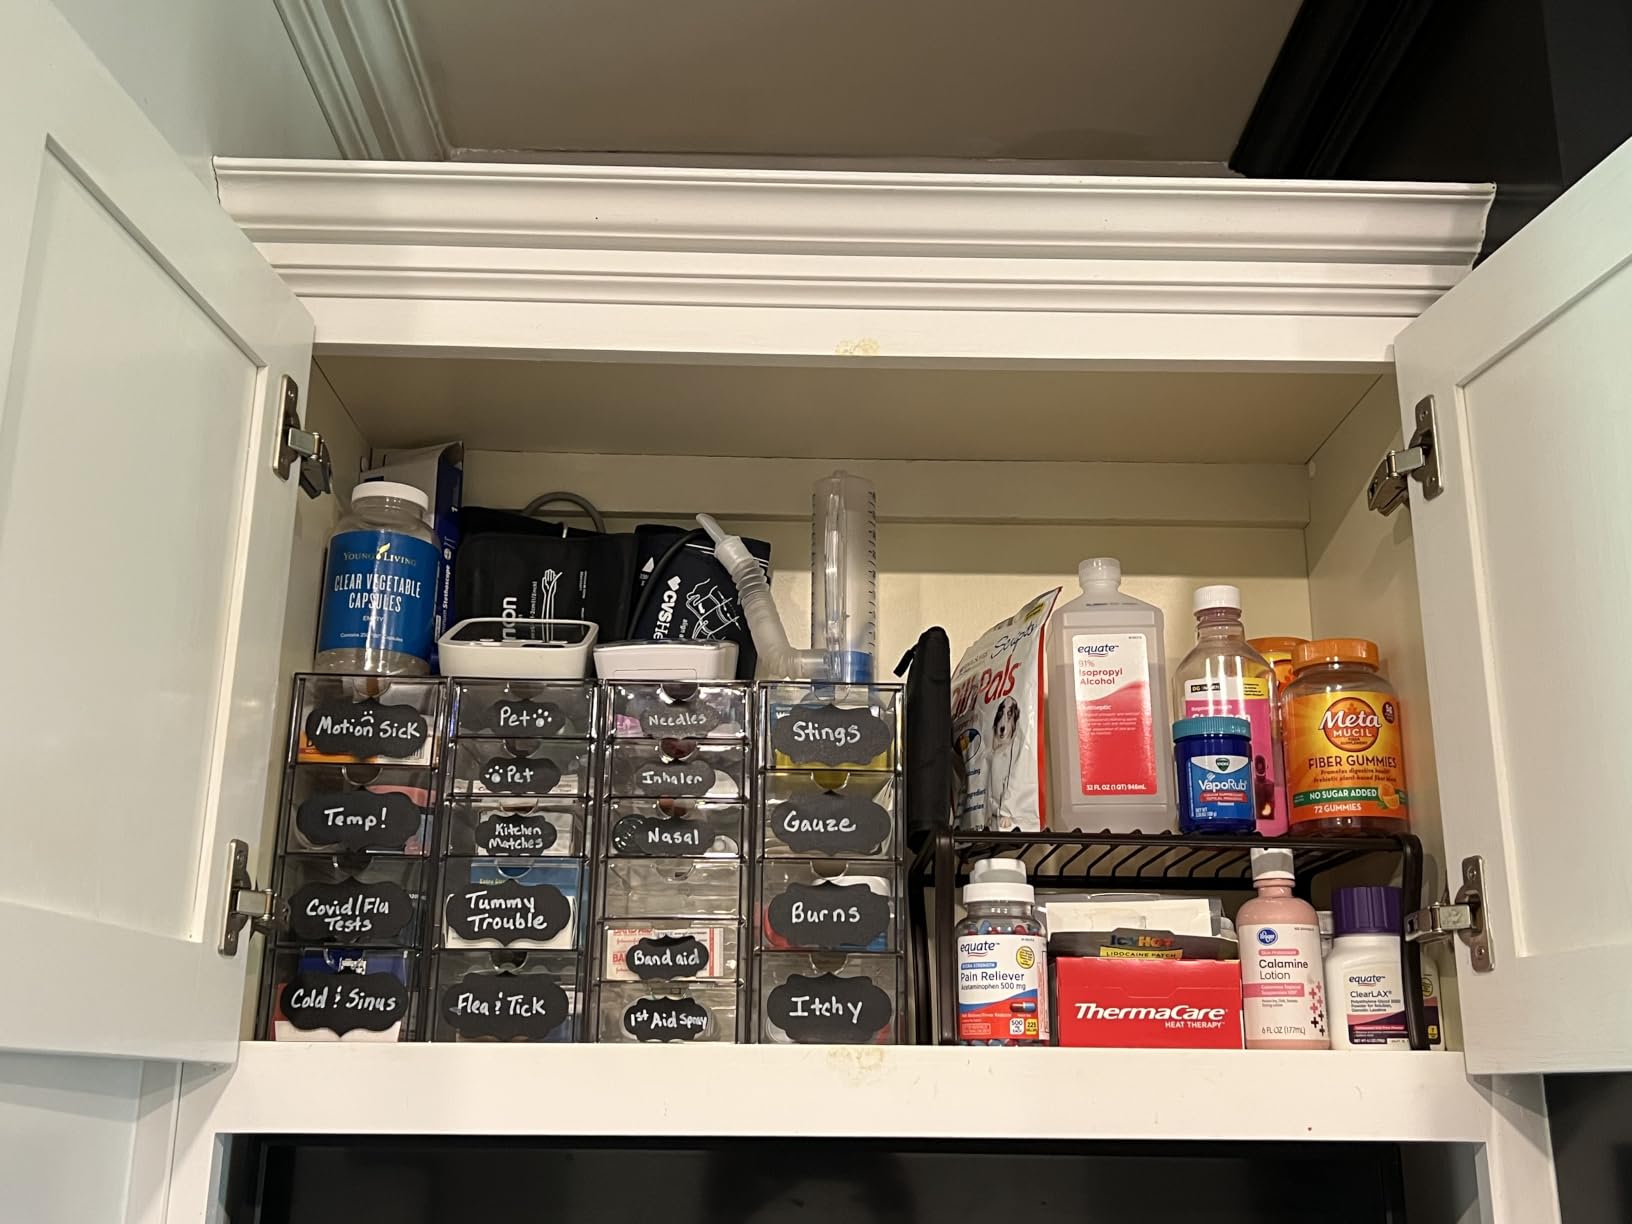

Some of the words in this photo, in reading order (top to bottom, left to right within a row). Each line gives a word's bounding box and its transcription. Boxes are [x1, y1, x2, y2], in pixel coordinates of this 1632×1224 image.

[383, 552, 417, 567] LIVING
[334, 573, 362, 592] CLEAR
[366, 573, 422, 598] VEGETABLE
[442, 564, 451, 609] Stethoscope
[348, 592, 402, 613] CAPSULES
[1077, 643, 1115, 656] equate
[1078, 659, 1095, 667] 91%
[978, 654, 1022, 705] Pals
[1079, 667, 1123, 677] Isopropyl
[1080, 677, 1115, 685] Alcohol
[500, 705, 530, 727] Pet
[648, 712, 707, 726] Needles
[1317, 710, 1383, 731] Meta
[315, 715, 374, 738] Motion
[792, 720, 861, 747] Stings
[1333, 728, 1373, 737] MUCIL
[1308, 755, 1343, 770] FIBER
[1346, 754, 1397, 769] GUMMIES
[507, 765, 535, 783] Pet
[1198, 778, 1247, 793] VapoRub
[1309, 792, 1321, 800] NO
[1322, 789, 1349, 799] SUGAR
[1350, 789, 1377, 798] ADDED
[1313, 805, 1323, 814] 72
[1324, 803, 1362, 813] GUMMIES
[323, 806, 388, 831] Temp!
[783, 810, 857, 833] Gauze
[494, 823, 542, 836] Kitchen
[647, 827, 699, 845] Nasal
[488, 836, 543, 849] Matches
[465, 890, 535, 912] Tummy
[791, 901, 861, 924] Burns
[324, 916, 373, 932] Tests
[466, 912, 548, 932] Trouble
[960, 941, 996, 955] equate
[633, 948, 673, 966] Band
[675, 948, 700, 965] aid
[1258, 959, 1309, 969] Calamine
[960, 971, 978, 982] Pain
[981, 970, 1025, 981] Reliever
[1259, 970, 1291, 980] Lotion
[1348, 974, 1382, 985] equate
[961, 983, 999, 991] Acetaminophen
[1000, 982, 1015, 990] 500
[1015, 983, 1026, 991] mg
[290, 986, 329, 1009] Cold
[345, 988, 397, 1011] Sinus
[456, 992, 490, 1016] Flea
[788, 995, 863, 1025] Itchy
[1074, 1002, 1225, 1021] ThermaCare
[630, 1009, 649, 1027] 1st
[650, 1011, 678, 1030] Aid
[679, 1013, 708, 1030] Spray
[1187, 1021, 1222, 1029] THERAPY
[1261, 1026, 1266, 1034] 6
[1284, 1026, 1306, 1035] (177mL)
